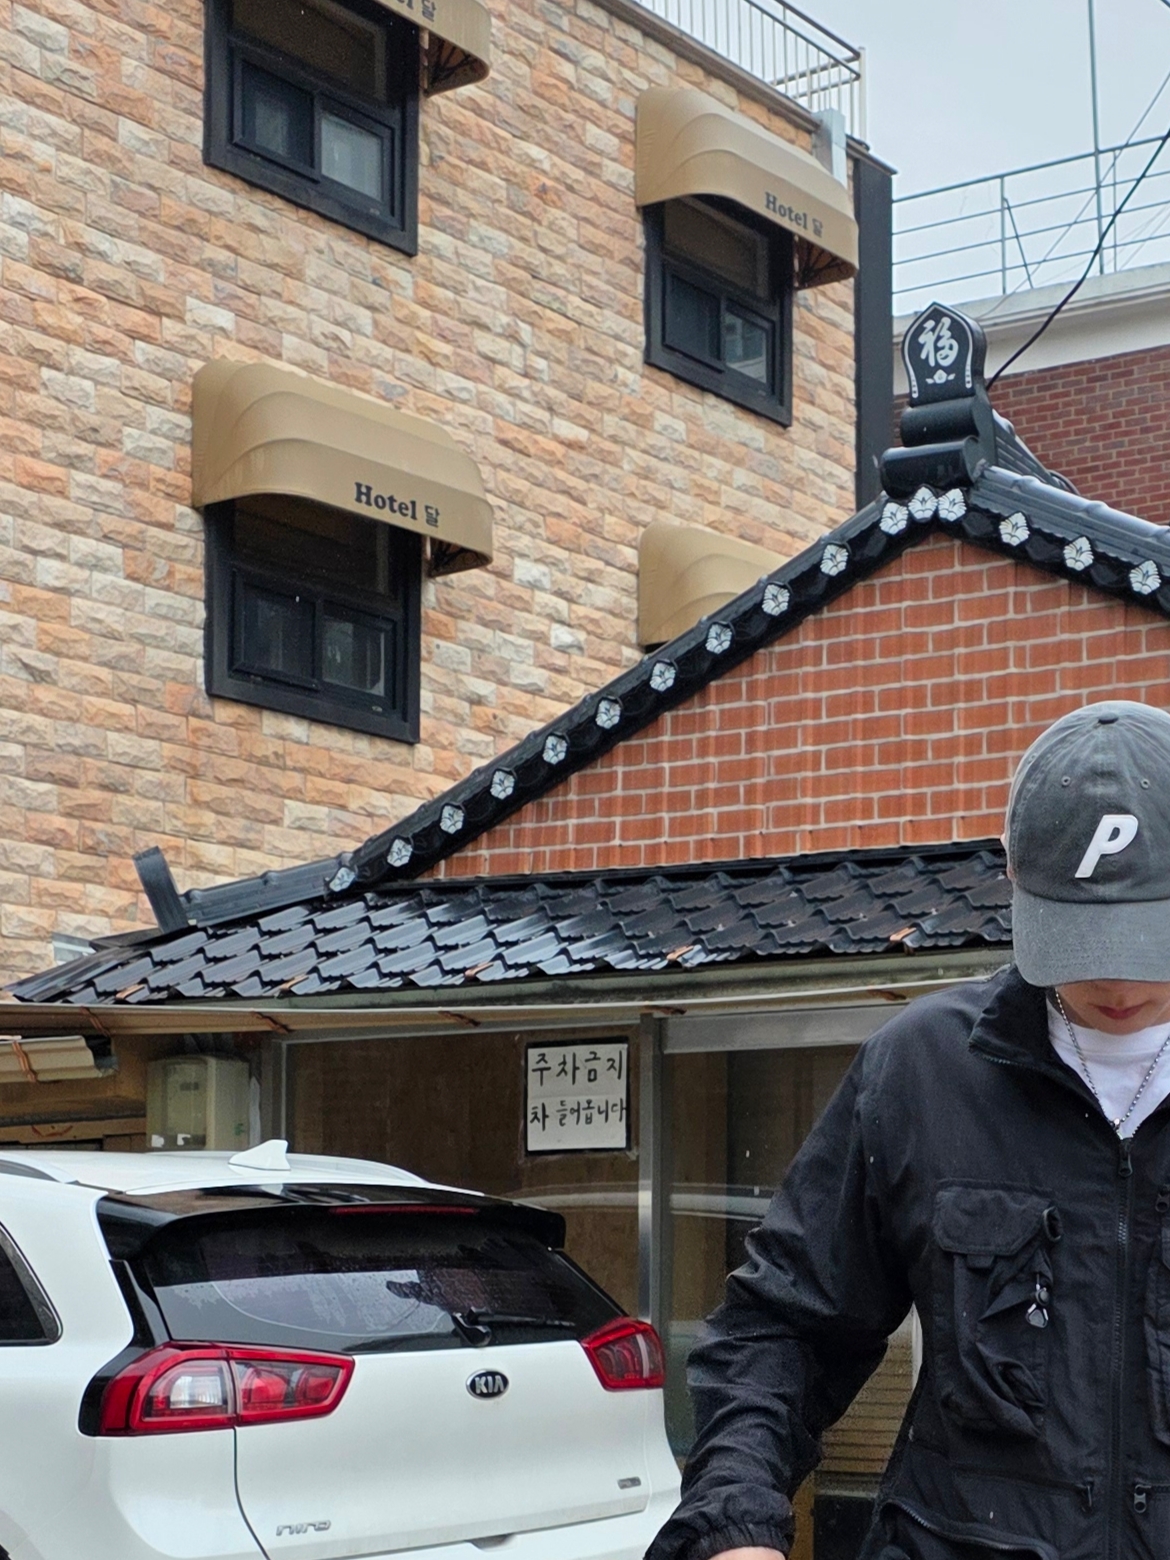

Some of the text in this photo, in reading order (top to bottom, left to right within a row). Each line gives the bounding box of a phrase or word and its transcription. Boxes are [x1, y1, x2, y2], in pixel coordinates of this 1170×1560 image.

[765, 191, 808, 230] Hotel
[354, 481, 440, 528] Hotel 달
[1074, 814, 1139, 879] P
[531, 1049, 623, 1087] 주차금지
[529, 1097, 627, 1132] 차 들어옵니다
[474, 1374, 505, 1394] KIA
